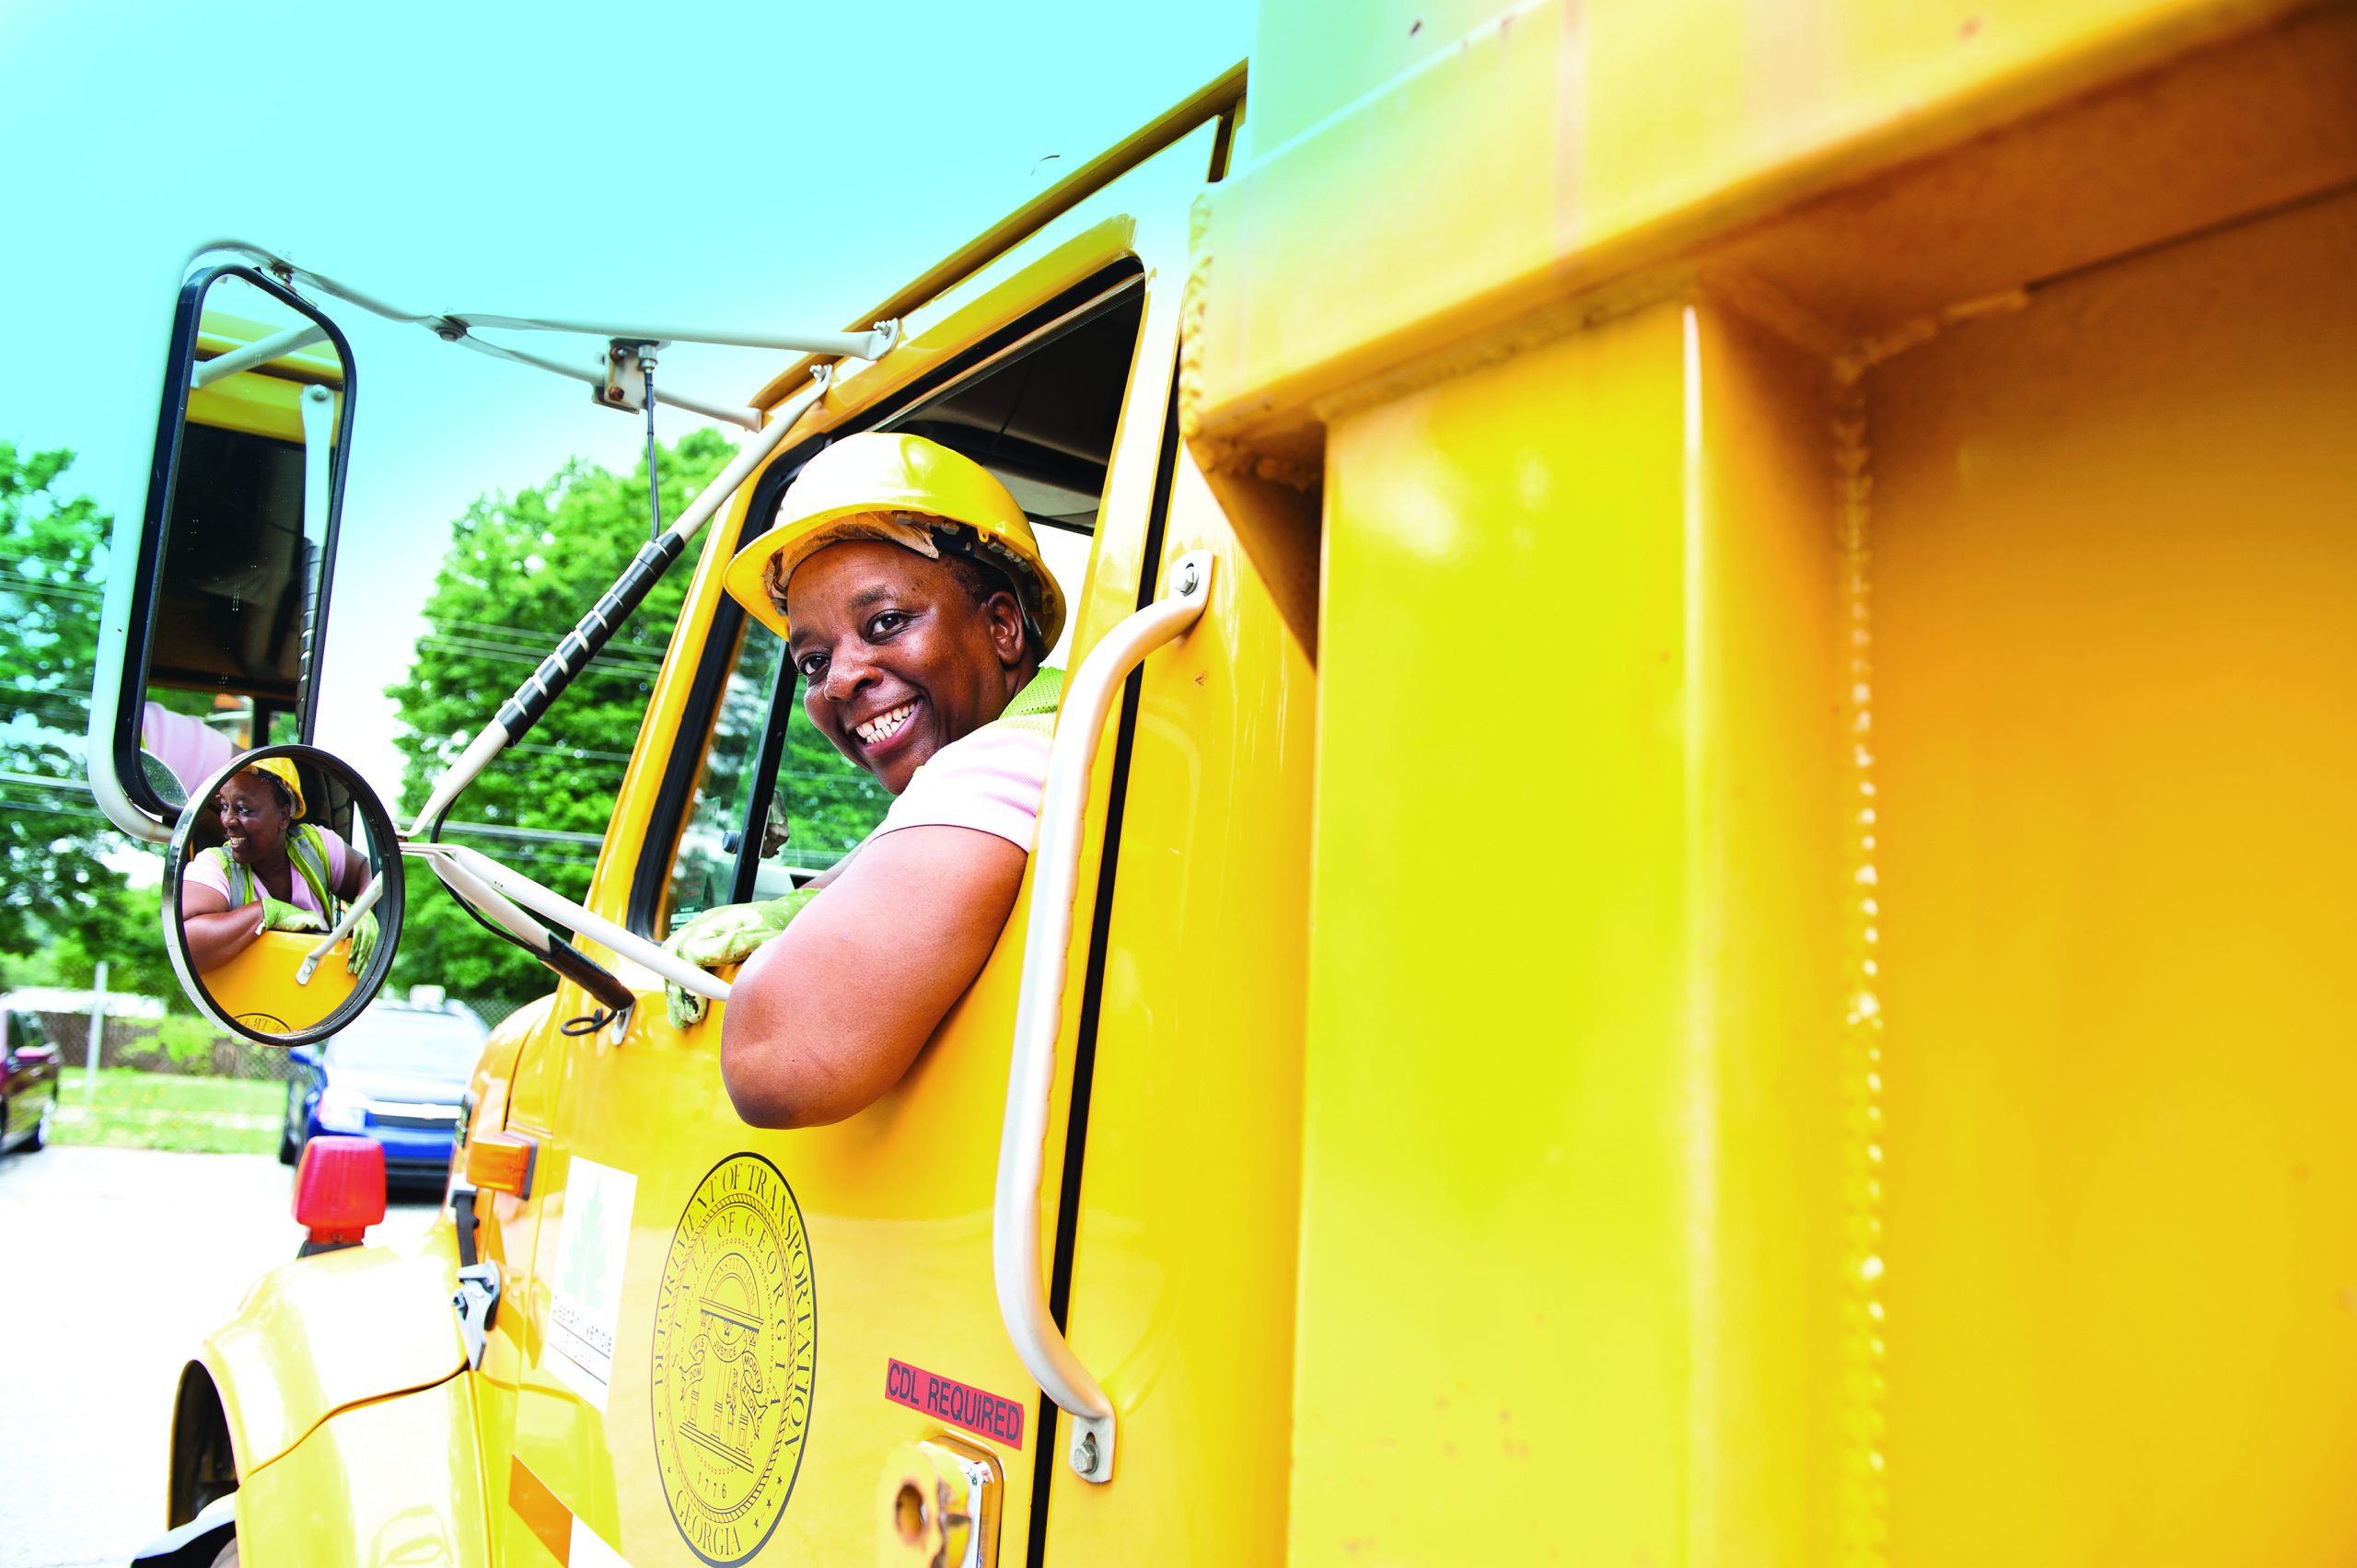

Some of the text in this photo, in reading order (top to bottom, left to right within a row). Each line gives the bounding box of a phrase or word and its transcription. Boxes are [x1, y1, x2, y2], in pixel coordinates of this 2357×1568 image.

[717, 1211, 736, 1237] OF
[745, 1214, 787, 1405] GEORGIA
[723, 1163, 742, 1192] OF
[749, 1164, 811, 1458] TRANSPORTATION
[714, 1340, 737, 1358] JUSTICE
[888, 1363, 1020, 1441] CDL REQUIRED
[698, 1471, 726, 1499] 1776
[676, 1490, 741, 1556] GEORGIA
